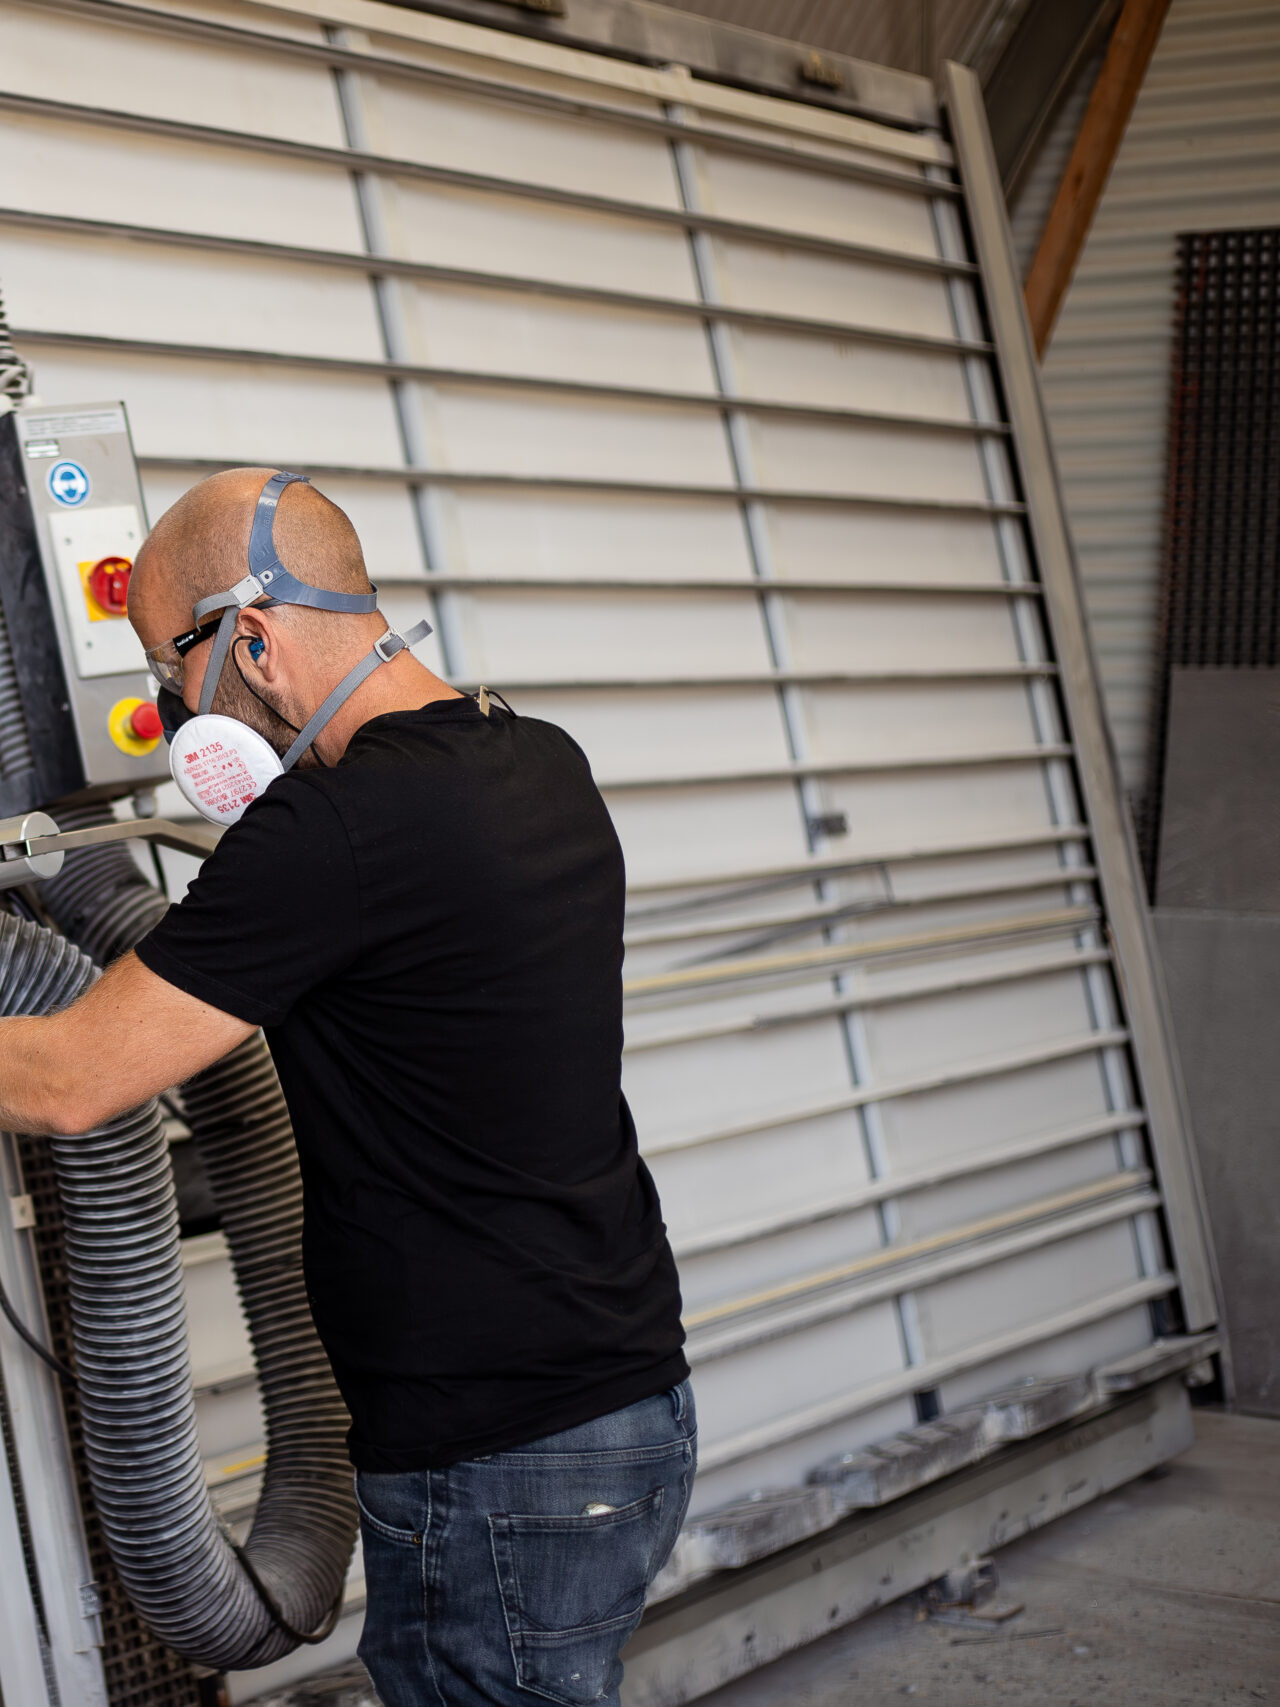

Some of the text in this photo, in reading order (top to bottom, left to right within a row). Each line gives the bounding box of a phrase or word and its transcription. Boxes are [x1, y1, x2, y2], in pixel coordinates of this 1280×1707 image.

[184, 741, 223, 764] 3M 2135
[239, 792, 257, 805] 3M
[217, 799, 240, 813] 2135
